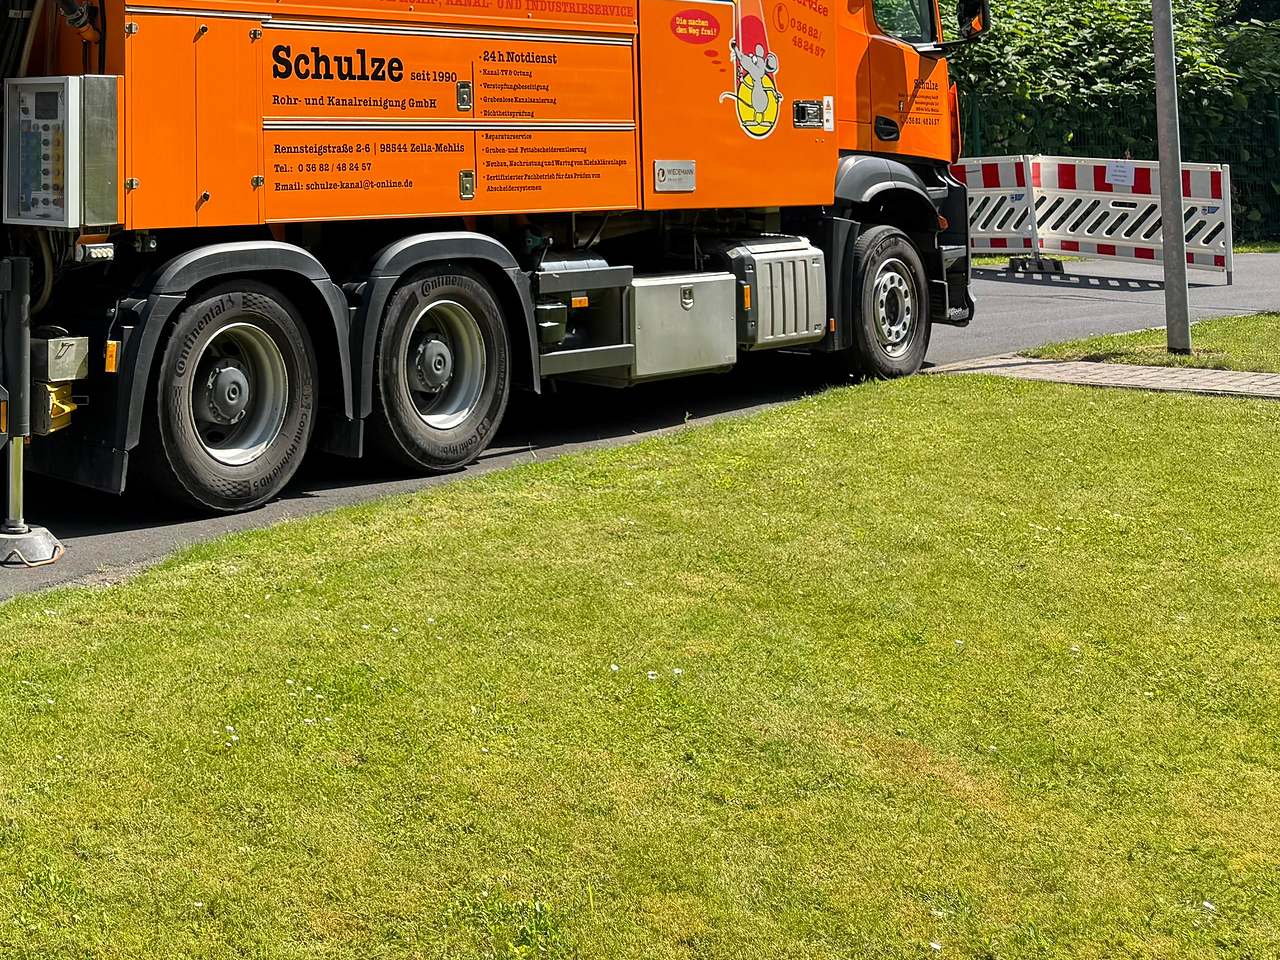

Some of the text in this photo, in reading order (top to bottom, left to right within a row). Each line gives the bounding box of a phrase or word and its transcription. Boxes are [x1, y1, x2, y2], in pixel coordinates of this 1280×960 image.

[525, 0, 634, 18] INDUSTRIESERVICE
[676, 16, 687, 25] Die
[676, 26, 717, 36] den Weg frei!
[272, 44, 458, 83] Schulze seit 1990
[506, 52, 558, 64] Notdienst
[272, 94, 437, 110] Rohr- und Kanalreinigung GmbH
[274, 144, 354, 156] Rennsteigstraße
[356, 144, 370, 153] 2-6
[380, 143, 408, 152] 98544
[410, 142, 465, 153] Zella-Mehlis
[274, 164, 293, 172] Tel.:
[274, 179, 413, 191] Email: schulze-kanal@t-online.de
